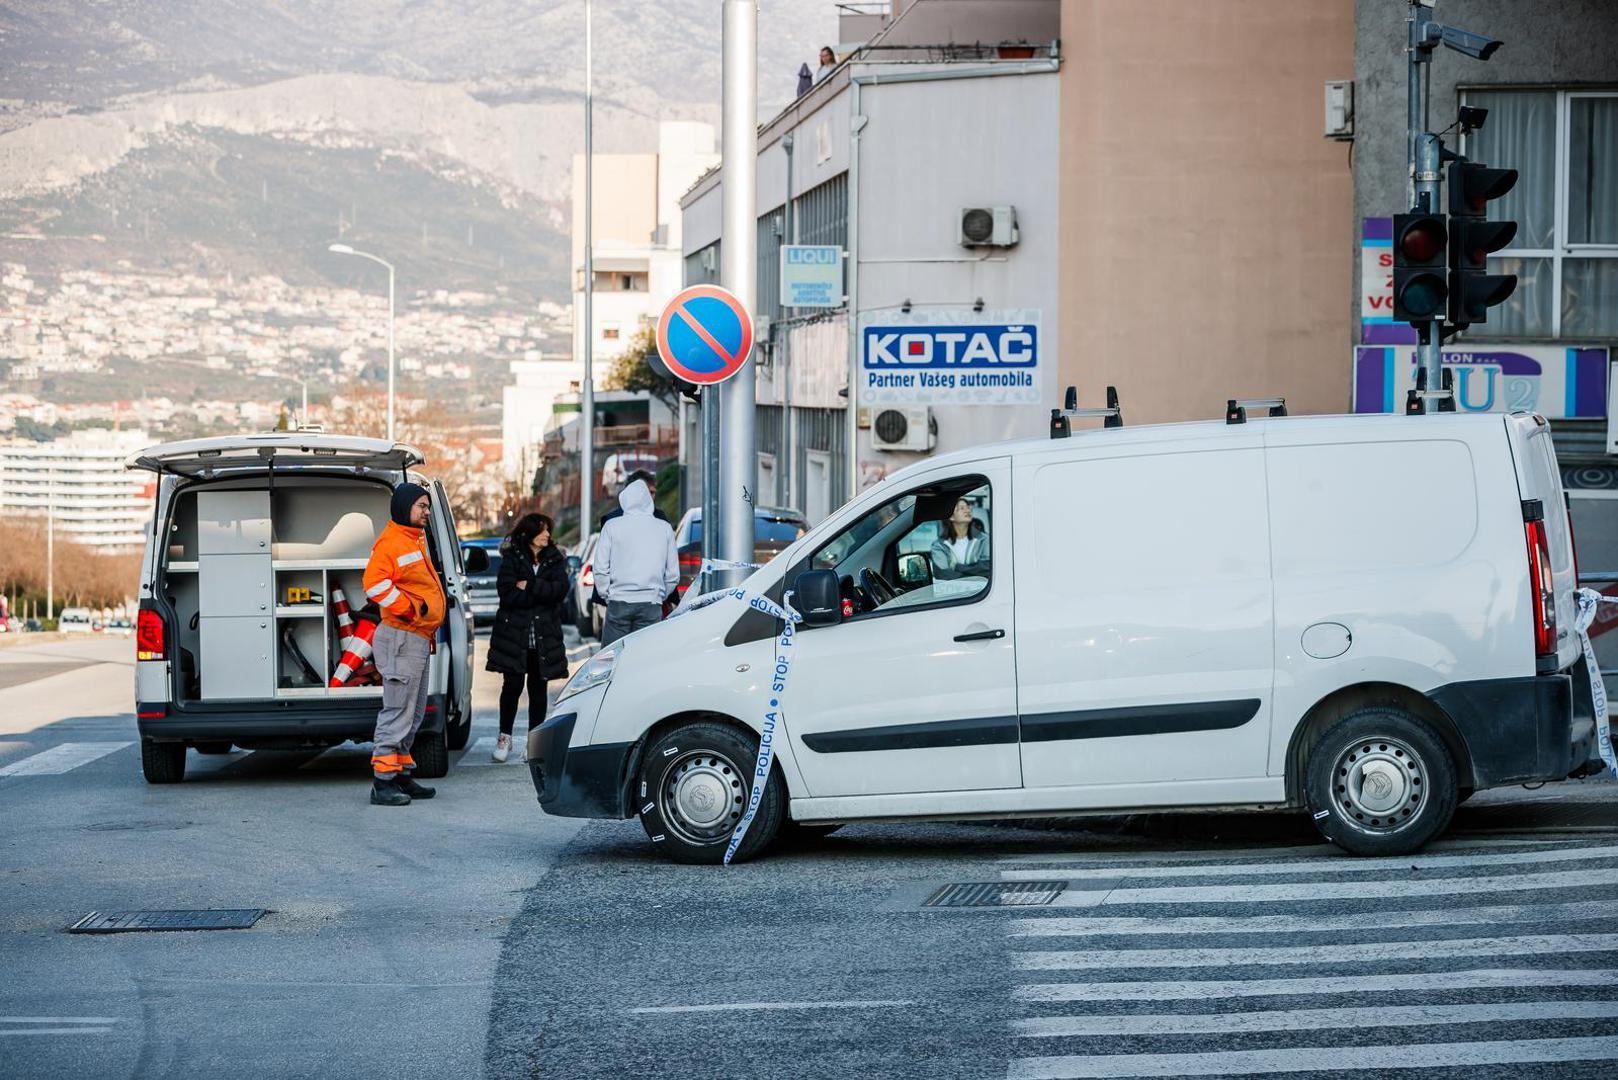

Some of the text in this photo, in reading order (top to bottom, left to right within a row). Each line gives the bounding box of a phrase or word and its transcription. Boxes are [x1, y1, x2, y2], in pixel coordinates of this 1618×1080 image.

[789, 249, 834, 263] LIQUI
[868, 326, 1033, 364] KOTAČ
[869, 371, 1032, 388] Partner Vašeg automobila
[1510, 378, 1534, 411] 2
[744, 786, 761, 822] STOP
[757, 712, 778, 777] POLICIJA
[772, 655, 789, 692] STOP
